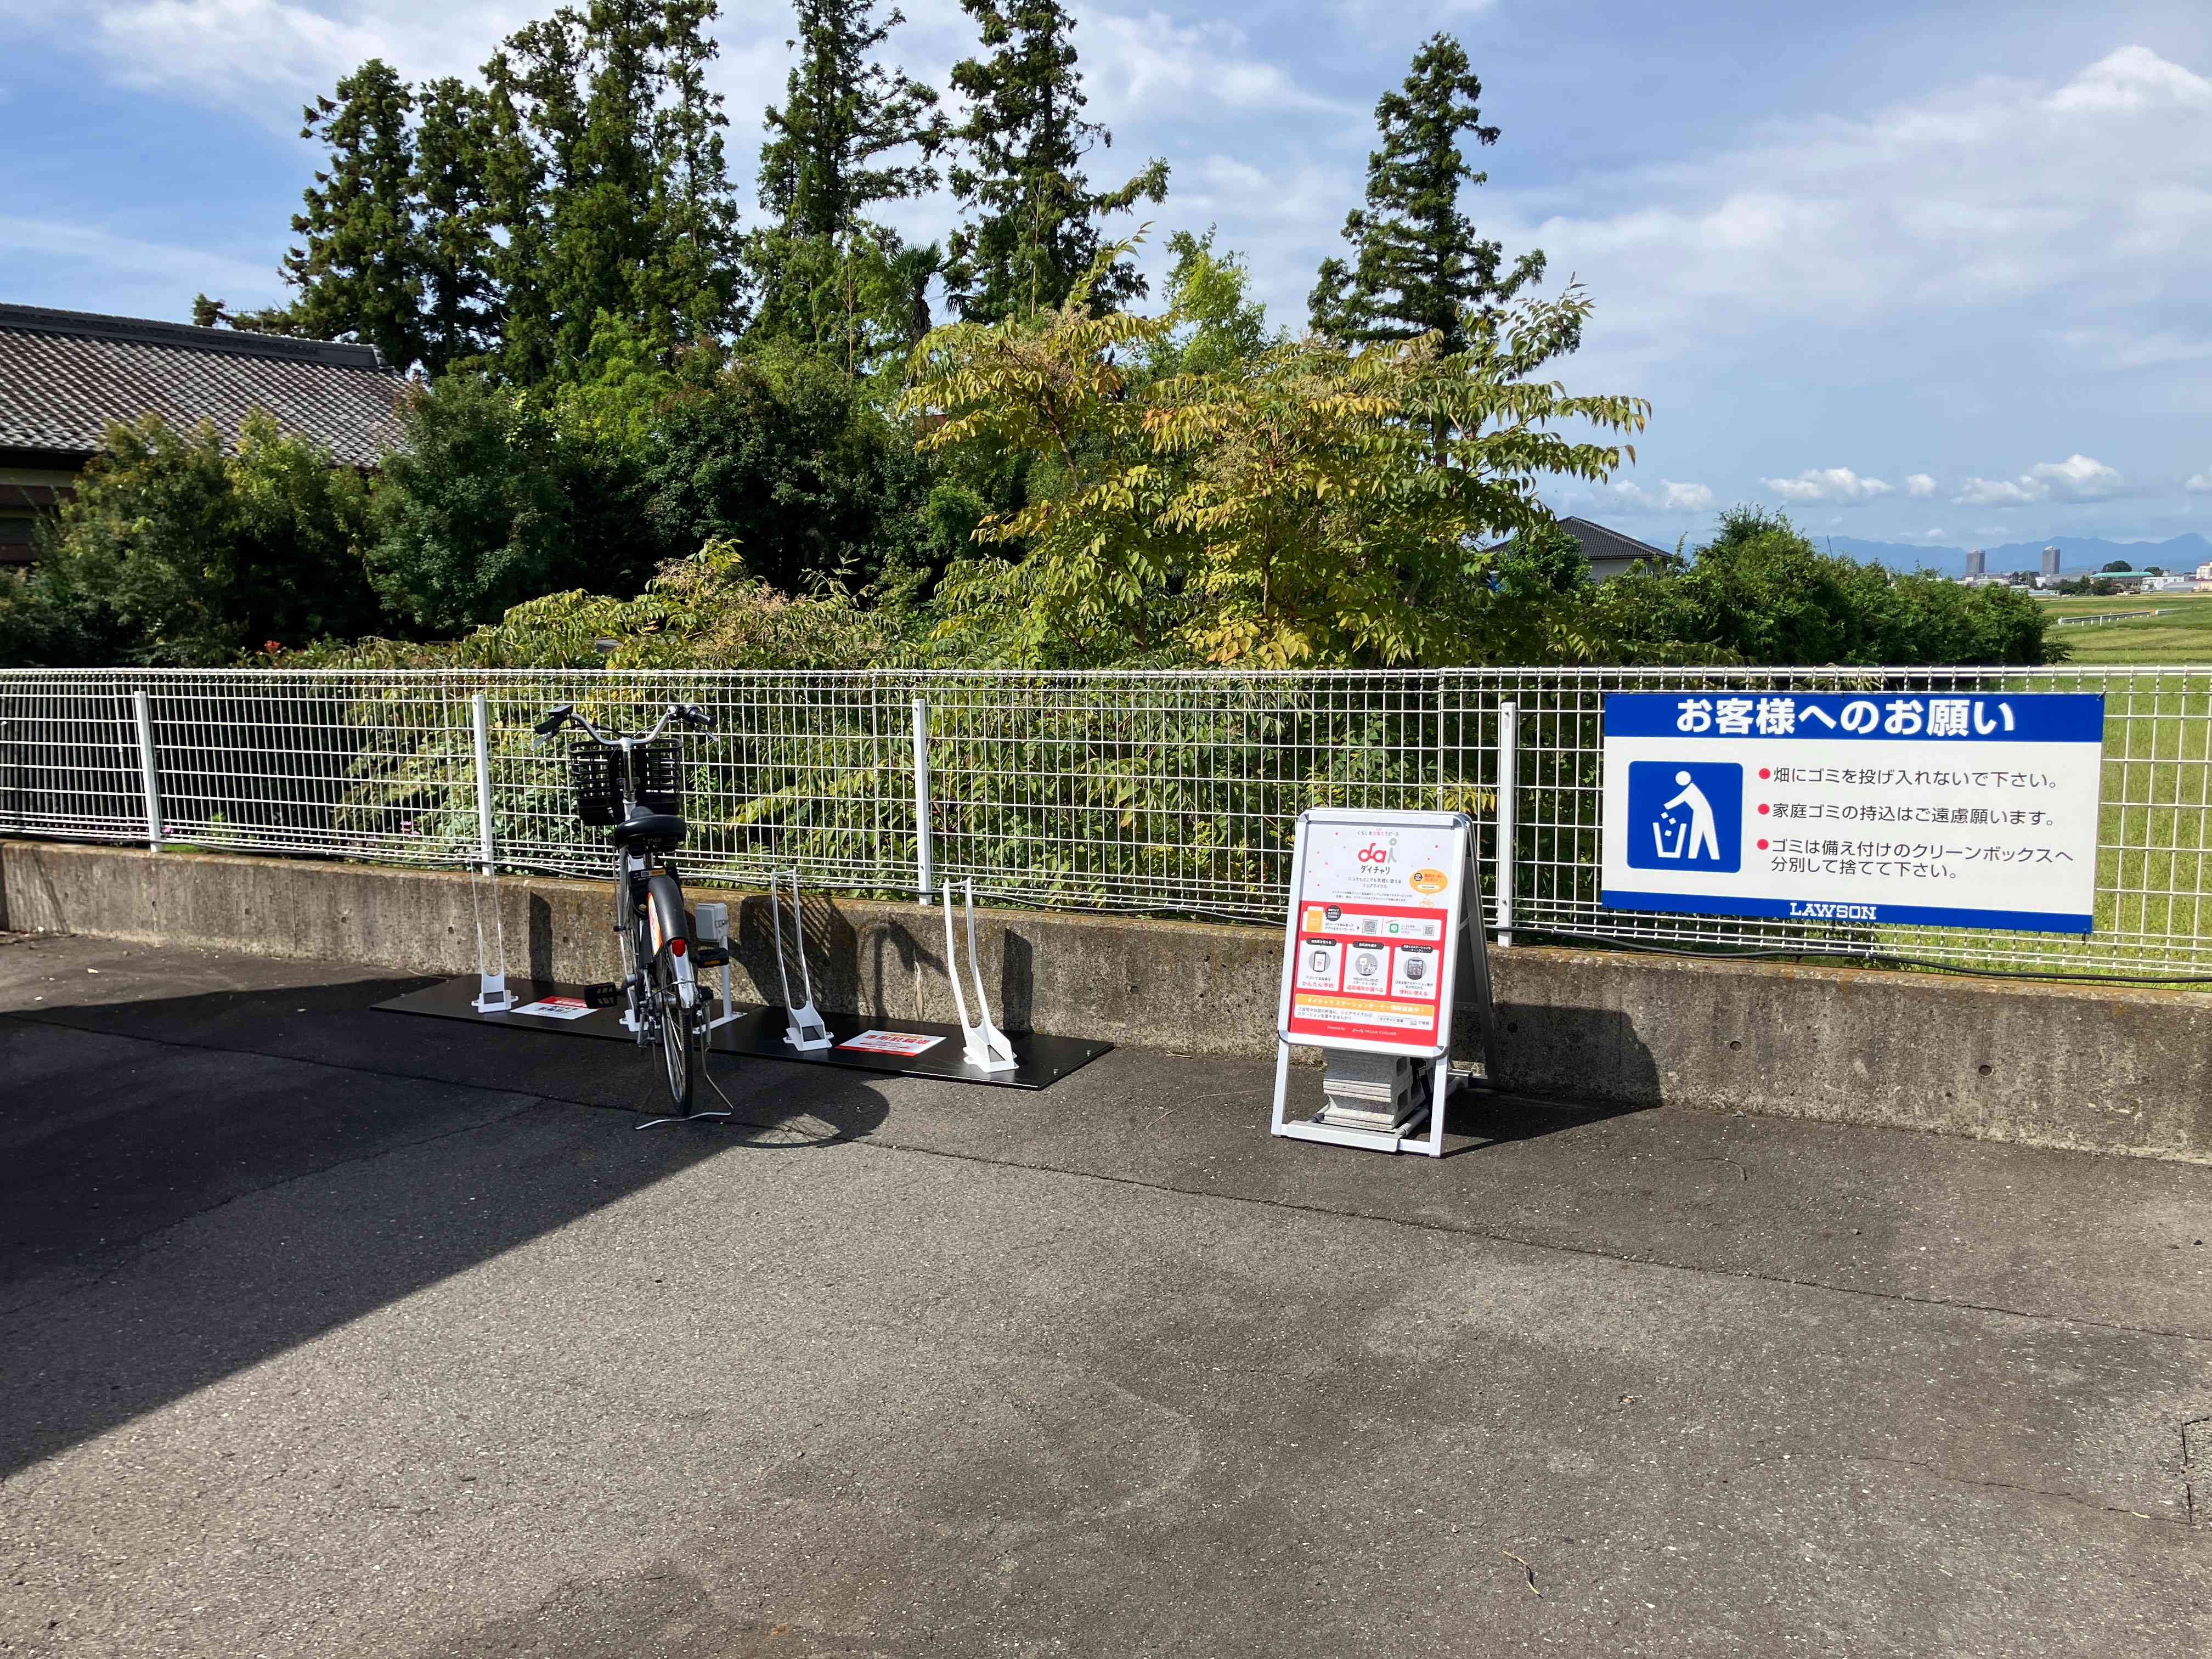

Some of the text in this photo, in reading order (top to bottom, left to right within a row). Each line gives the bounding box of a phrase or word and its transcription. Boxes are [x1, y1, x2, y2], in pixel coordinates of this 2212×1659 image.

[1676, 698, 2014, 737] お客様へのお願い
[1773, 767, 2057, 788] 畑にゴミを投げ入れないで下さい。
[1773, 803, 2053, 826] 家庭ゴミの持込はご遠慮願います。
[1771, 839, 2074, 864] ゴミは備え付けのクリーンボックスへ
[1361, 865, 1391, 874] ダイチャリ
[1771, 856, 1957, 879] 分別して捨てて下さい。
[1790, 901, 1877, 921] LAWSON
